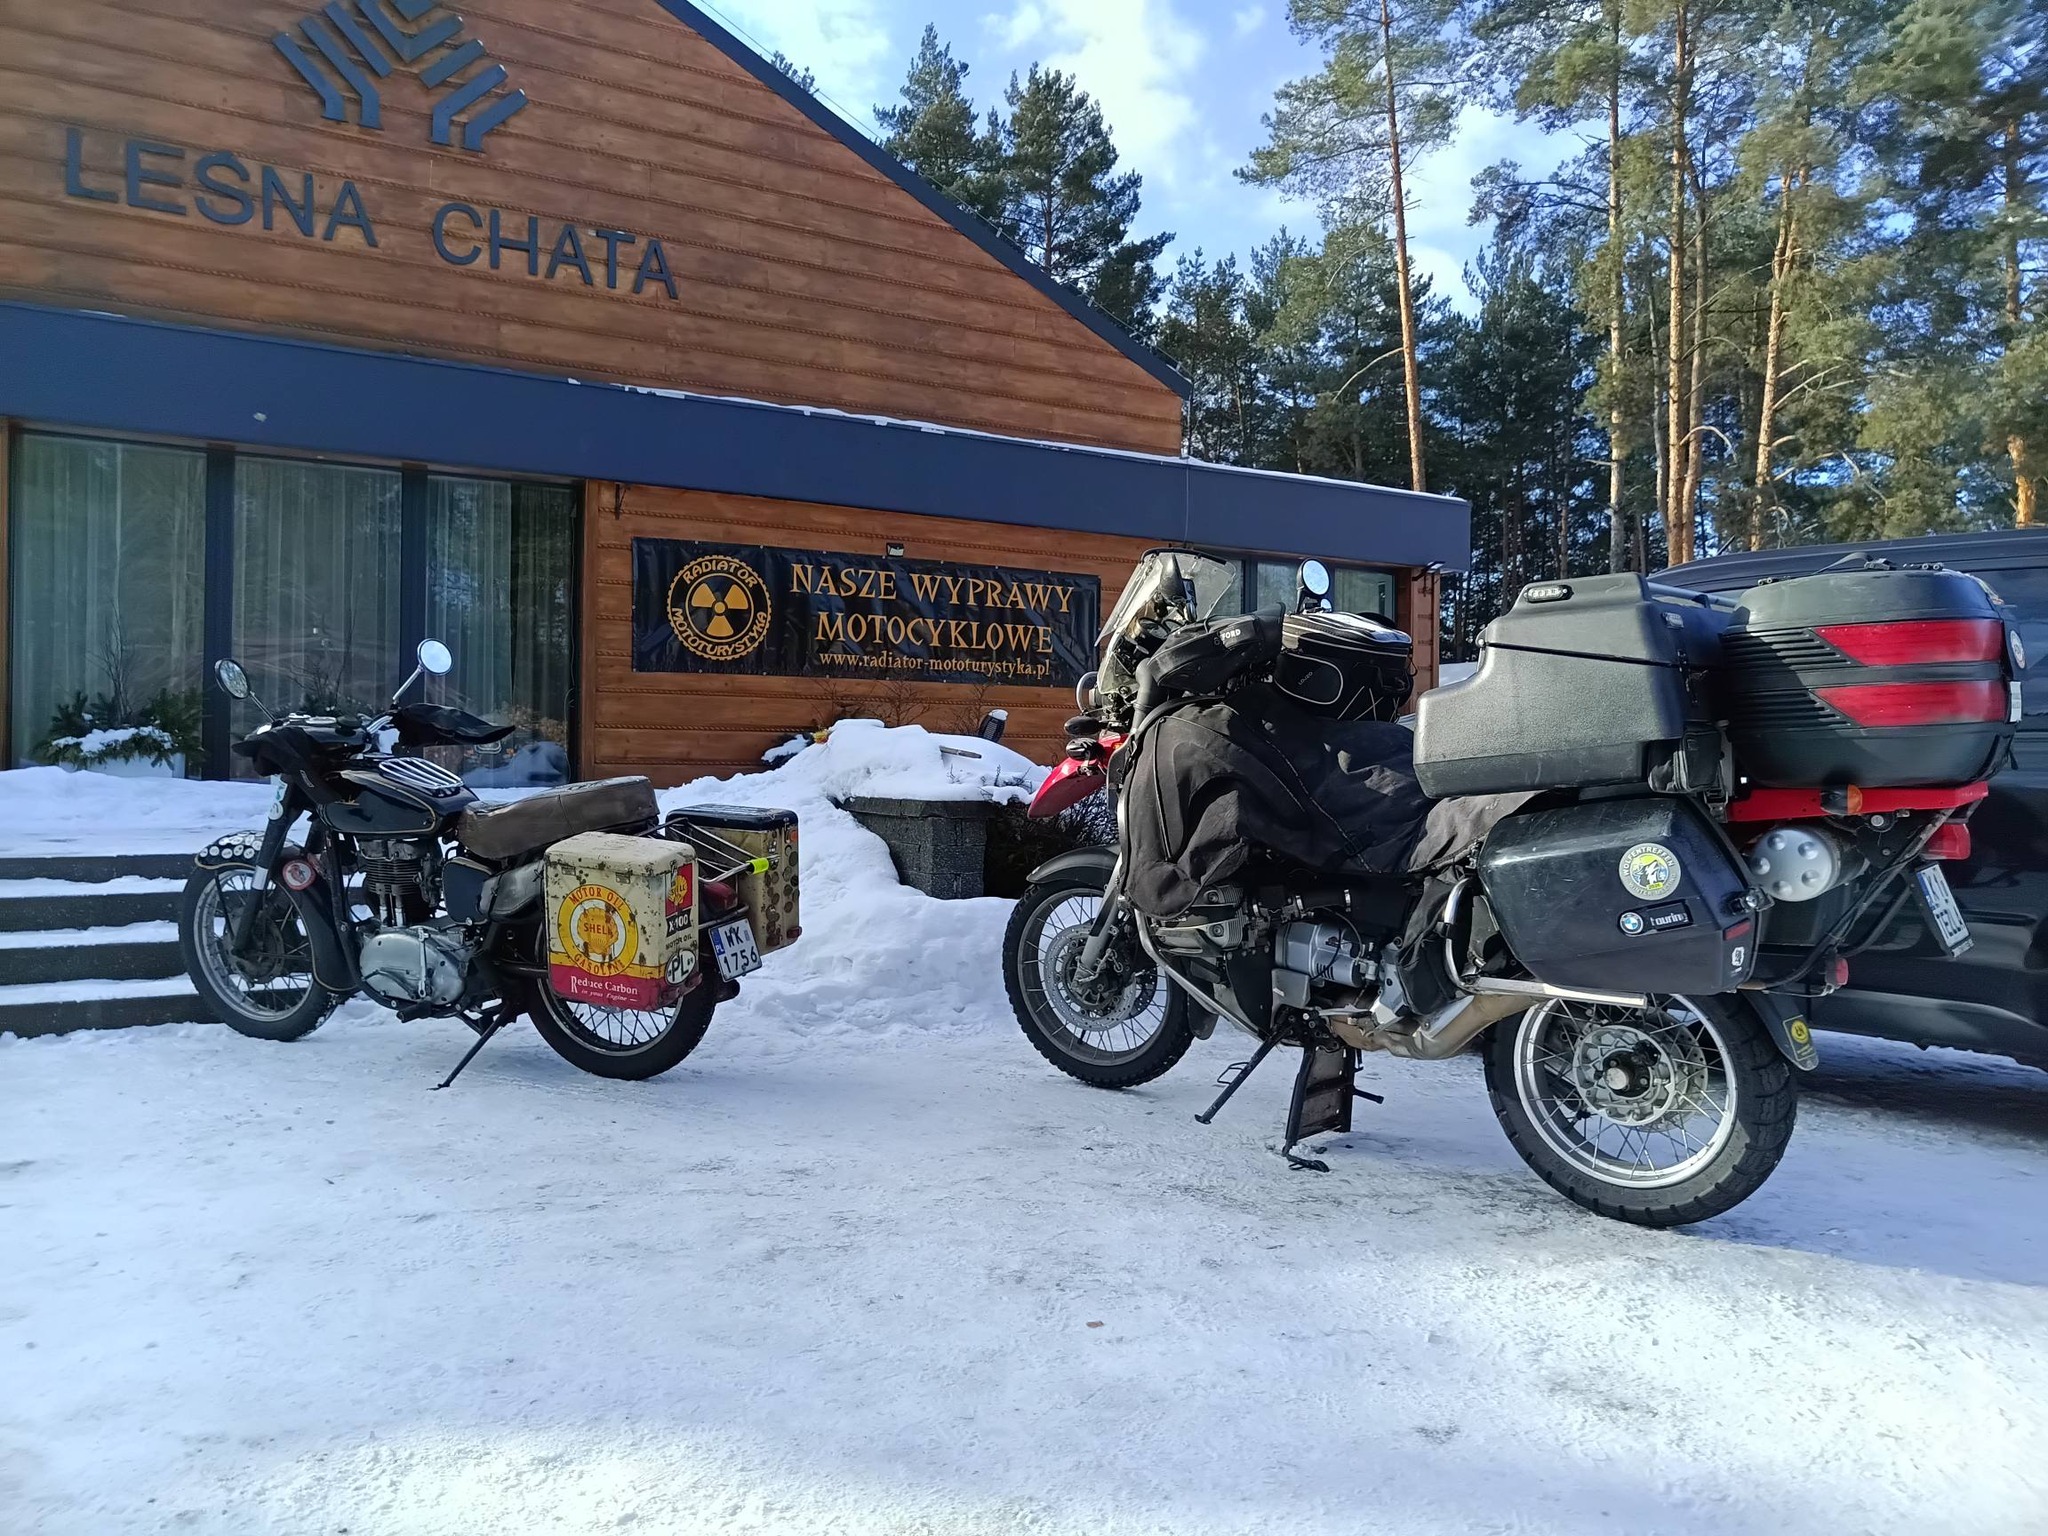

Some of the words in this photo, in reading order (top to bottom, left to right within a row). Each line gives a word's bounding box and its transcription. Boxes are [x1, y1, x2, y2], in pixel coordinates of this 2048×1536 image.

[433, 202, 679, 299] CHATA
[682, 559, 758, 588] RADIATOR
[789, 563, 897, 600] NASZE
[909, 573, 1075, 613] WYPRAWY
[671, 607, 767, 656] MOTOTURYSTYKA
[815, 611, 1053, 653] MOTOCYKLOWE
[819, 650, 1050, 680] www.radiator-mototurystyka.pl
[1622, 846, 1675, 877] WOLFENTREFFEN
[569, 886, 602, 905] MOTOR
[607, 892, 625, 911] OIL
[671, 954, 690, 982] PL
[723, 946, 758, 974] 1756
[571, 975, 603, 994] Reduce
[604, 981, 638, 995] Carbon
